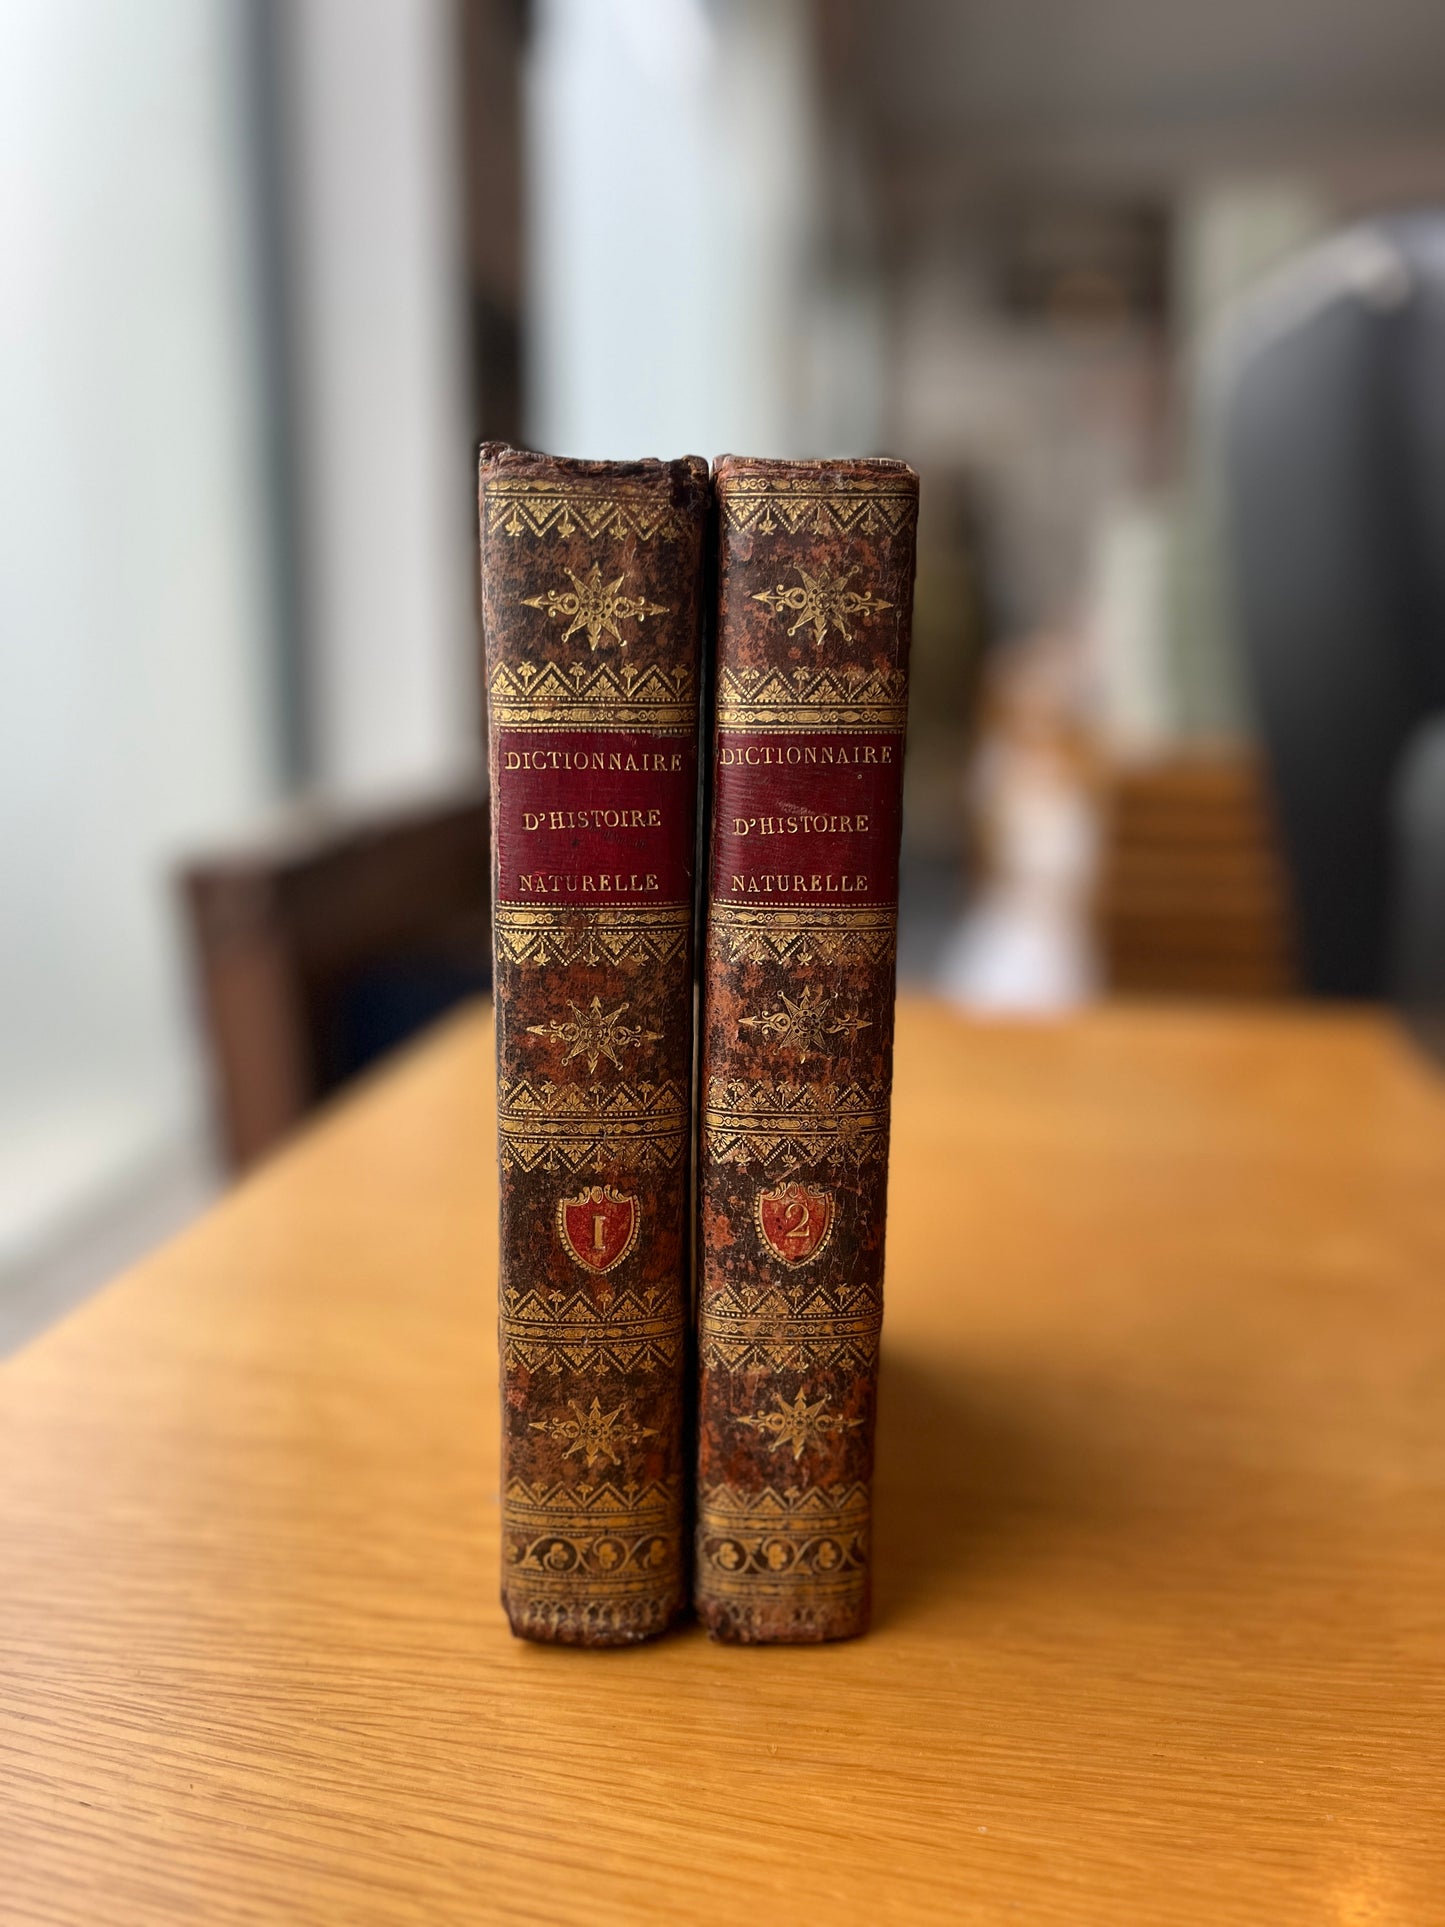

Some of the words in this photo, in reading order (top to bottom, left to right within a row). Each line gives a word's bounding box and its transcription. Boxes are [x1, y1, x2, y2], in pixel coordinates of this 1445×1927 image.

[504, 750, 683, 772] DICTIONNAIRE
[719, 746, 893, 765] DICTIONNAIRE
[519, 874, 660, 892] NATURELLE
[731, 874, 869, 892] NATURELLE
[784, 1203, 810, 1237] 2
